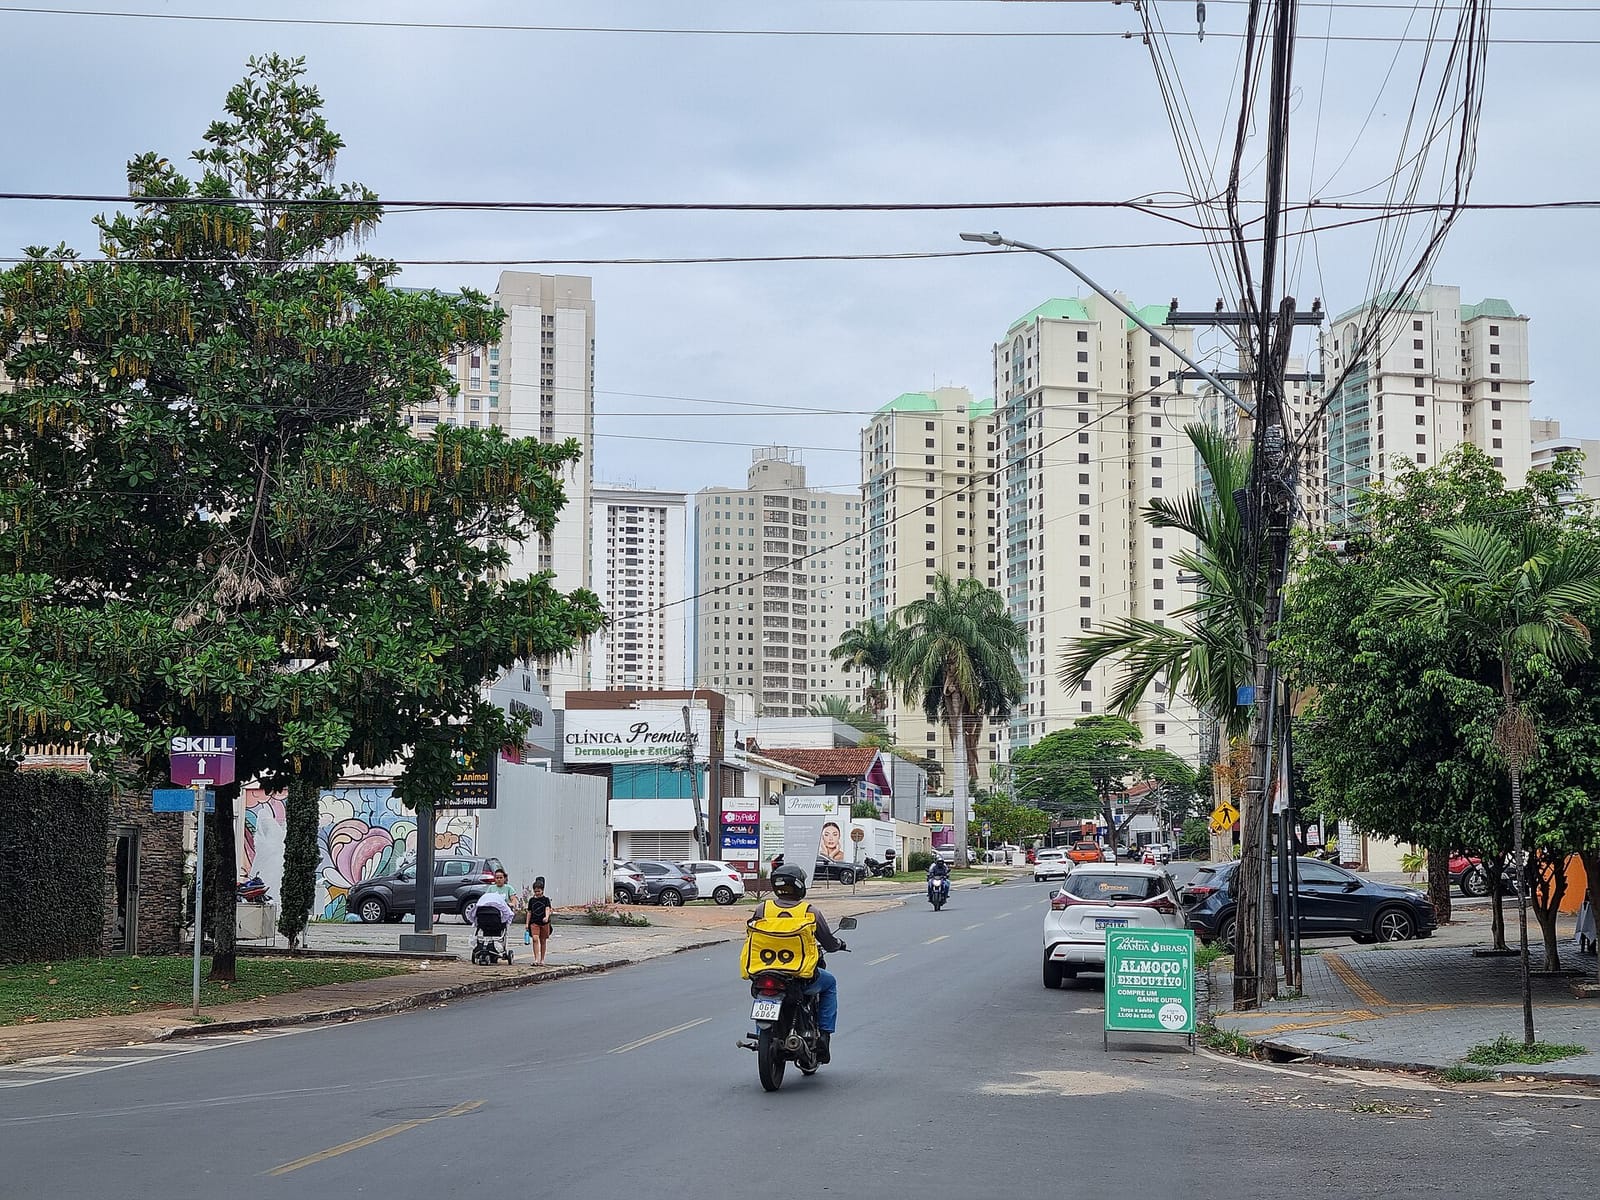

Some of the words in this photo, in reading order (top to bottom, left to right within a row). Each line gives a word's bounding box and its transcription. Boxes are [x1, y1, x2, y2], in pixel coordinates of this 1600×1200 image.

[565, 729, 622, 745] CLÍNICA
[172, 737, 233, 752] SKILL
[574, 746, 638, 758] Dermatologia
[647, 746, 687, 757] Estétic
[462, 772, 489, 781] Animal
[1160, 944, 1188, 952] BRASA
[760, 948, 794, 965] 99
[1119, 960, 1181, 977] ALMOÇO
[1118, 976, 1182, 986] EXECUTIVO
[755, 1010, 777, 1018] 6D62
[1161, 1014, 1185, 1022] 24,90
